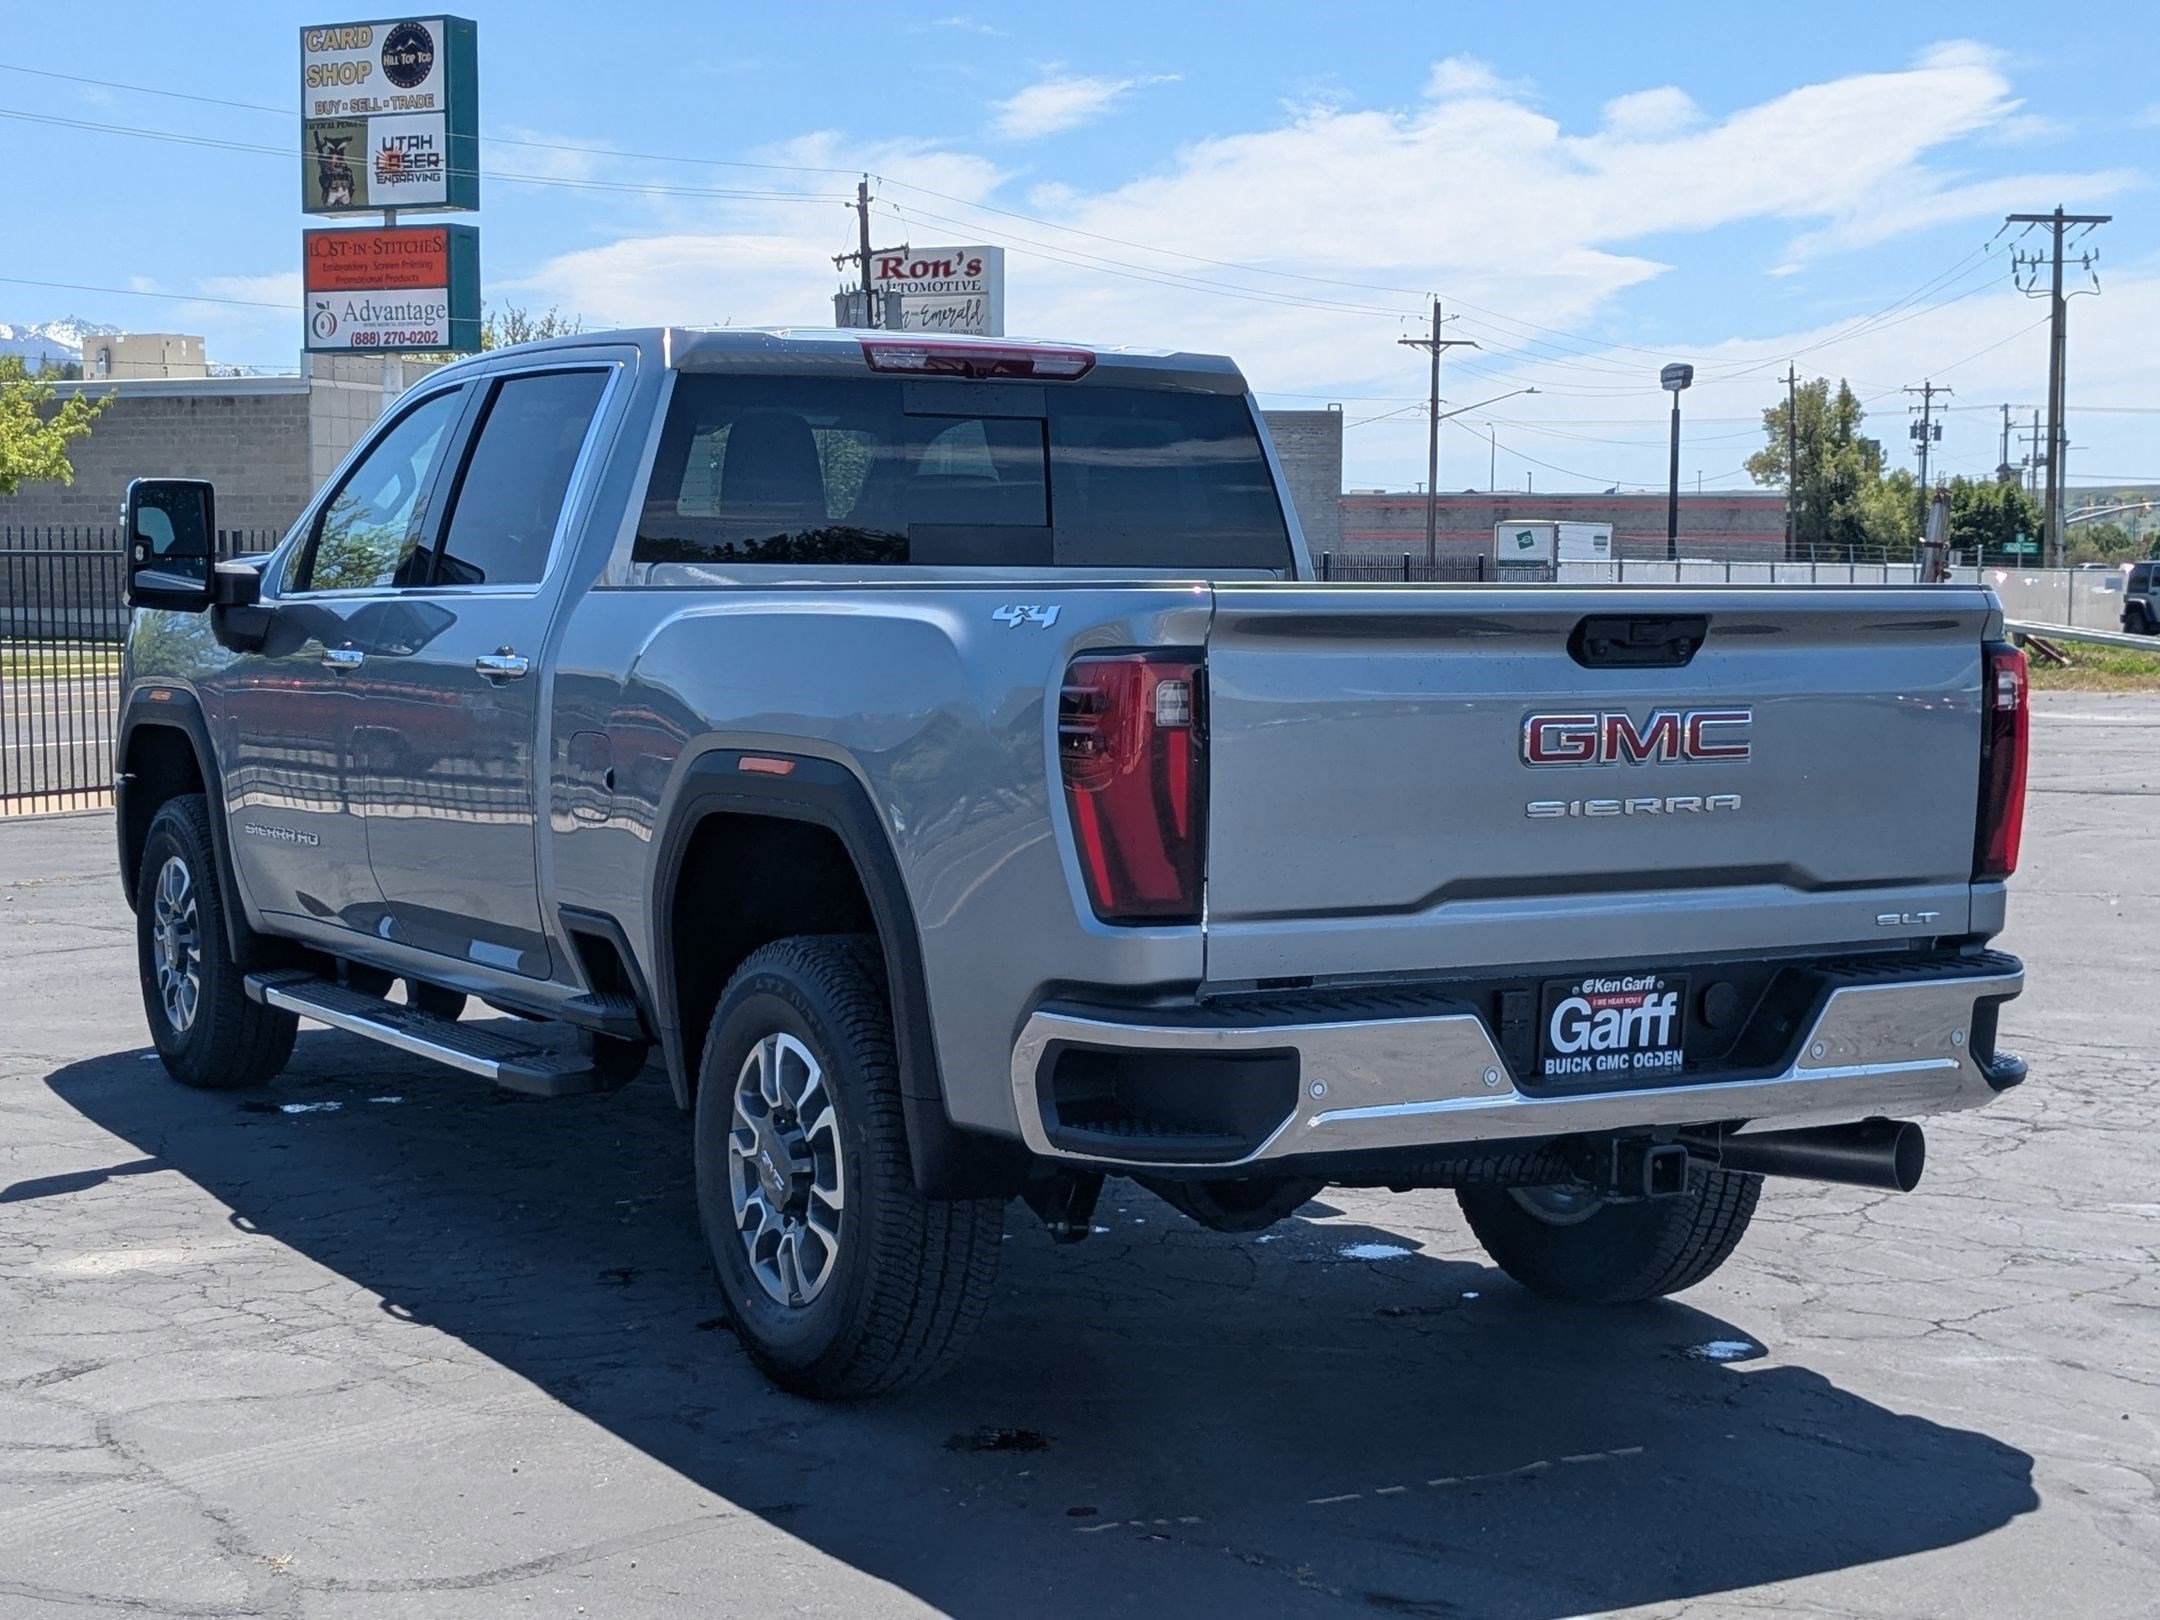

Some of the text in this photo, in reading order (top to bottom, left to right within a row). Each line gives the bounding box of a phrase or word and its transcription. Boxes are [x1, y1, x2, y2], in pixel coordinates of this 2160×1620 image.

[306, 25, 373, 52] CARD
[383, 54, 399, 66] HILL
[401, 52, 416, 65] TOP
[306, 61, 373, 88] SHOP
[315, 93, 434, 115] BUY SELL TRADE
[382, 134, 432, 151] UTAH
[375, 172, 440, 185] ENGRAVING
[874, 250, 982, 280] Ron's
[342, 300, 446, 326] Advantage
[921, 299, 984, 327] Emerald
[351, 330, 438, 346] (888) 270-0202
[1522, 709, 1753, 767] GMC
[1525, 794, 1742, 819] SIERRA
[245, 822, 320, 847] SIERRA HD
[1876, 911, 1940, 926] SLT
[1592, 975, 1656, 993] Ken Garff
[1608, 997, 1624, 1005] HEAR
[1550, 992, 1677, 1053] Garff
[1545, 1050, 1683, 1075] BUICK GMC OGDEN
